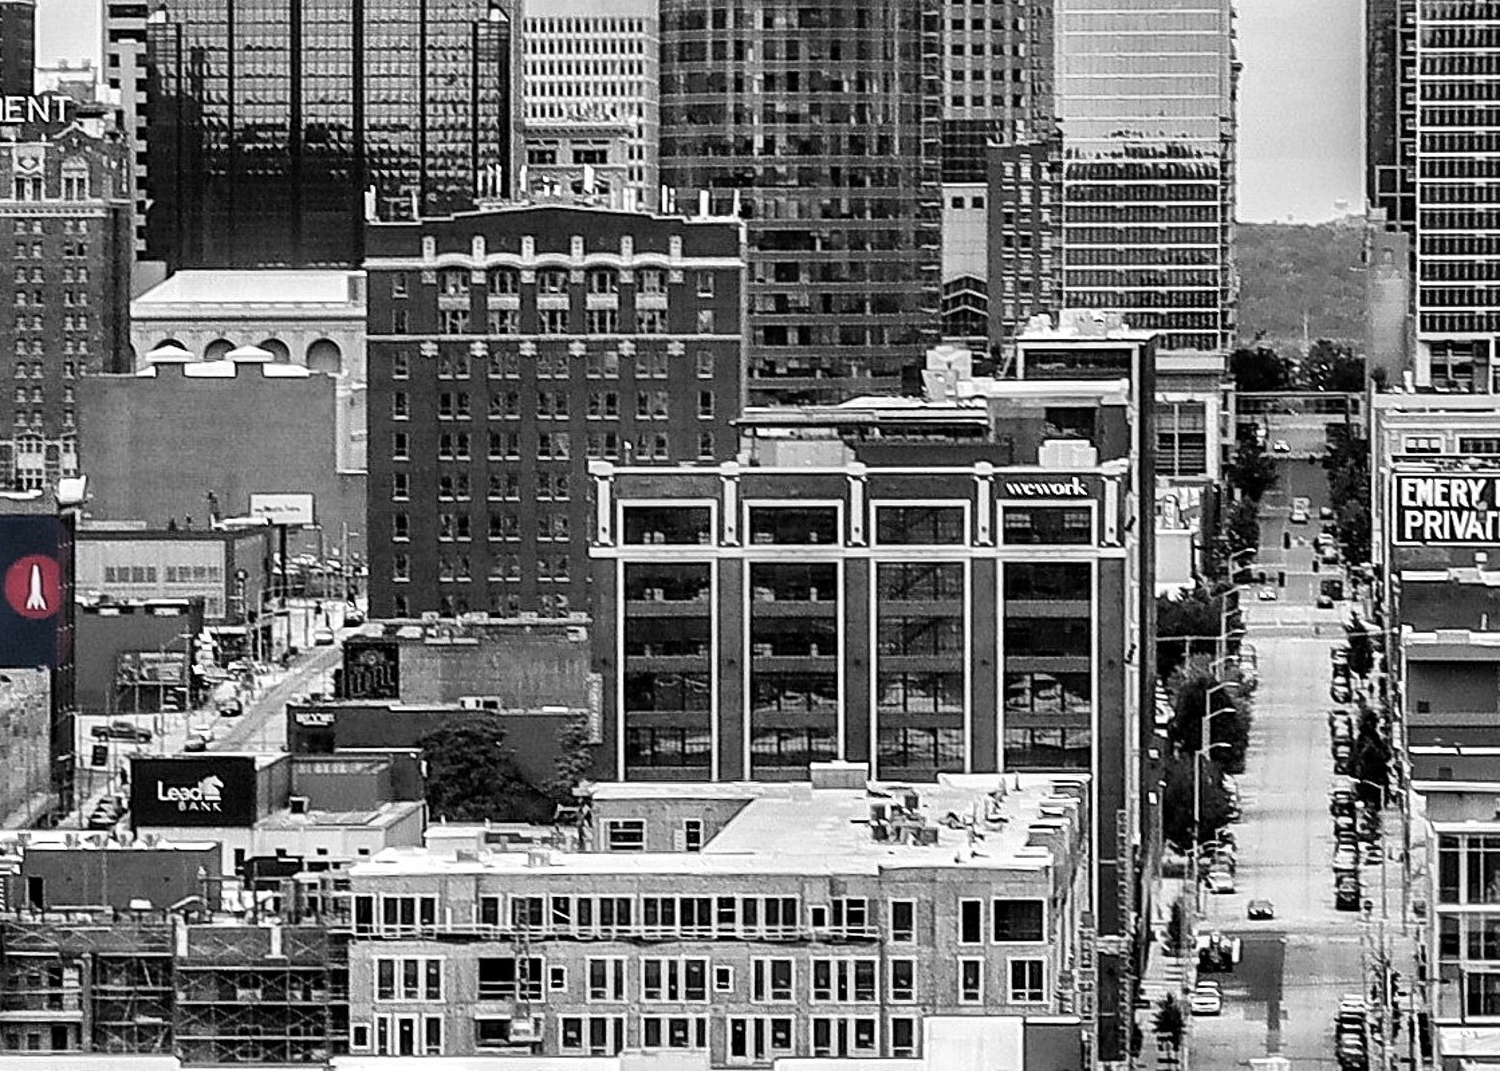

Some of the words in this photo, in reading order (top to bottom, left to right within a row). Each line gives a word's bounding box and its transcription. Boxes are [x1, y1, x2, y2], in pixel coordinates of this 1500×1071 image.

[1006, 476, 1088, 496] wework
[1401, 478, 1487, 510] EMERY
[1404, 509, 1500, 540] PRIVAT
[157, 780, 203, 801] Lead
[178, 801, 222, 812] BANK
